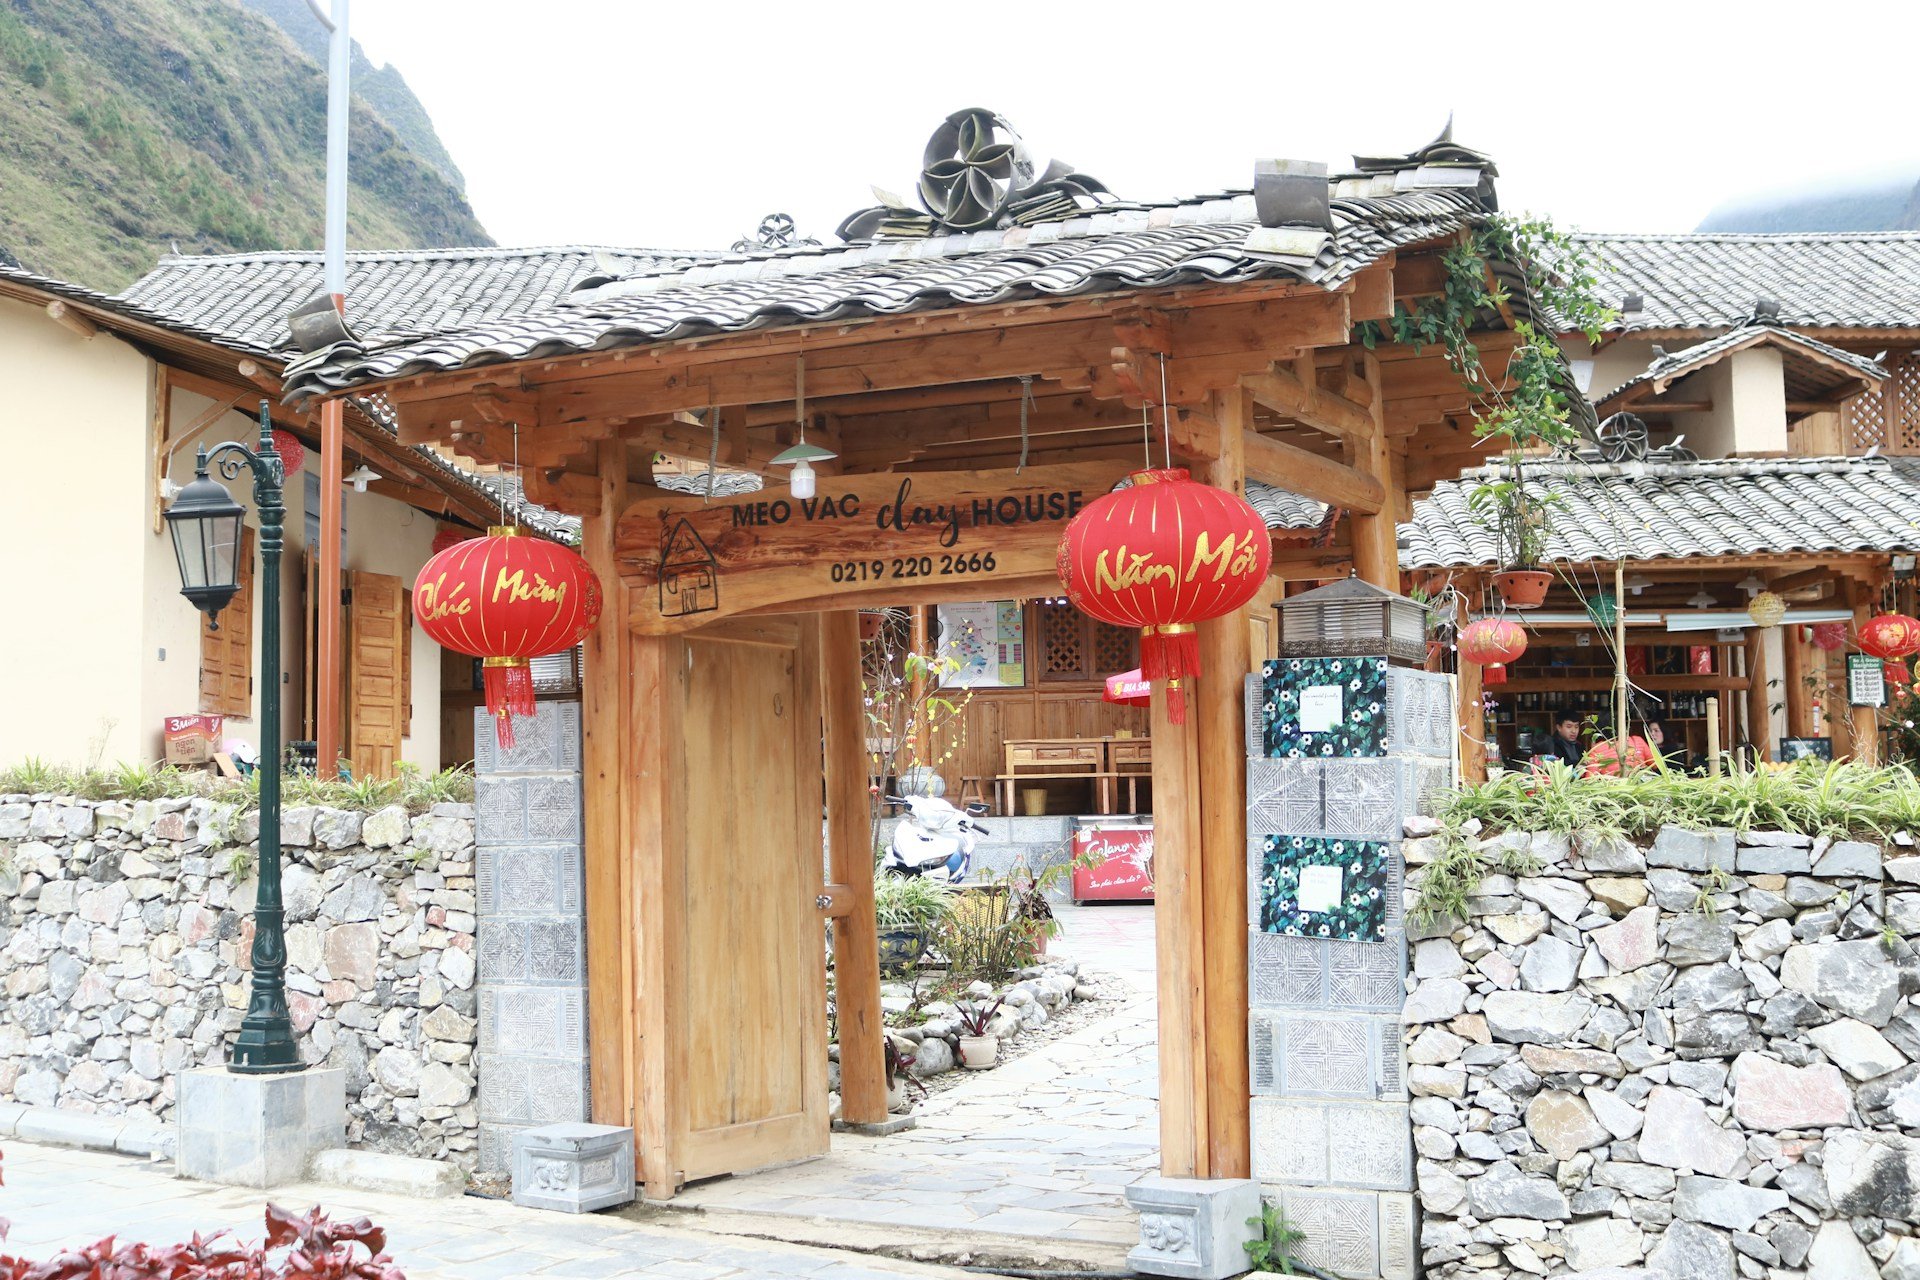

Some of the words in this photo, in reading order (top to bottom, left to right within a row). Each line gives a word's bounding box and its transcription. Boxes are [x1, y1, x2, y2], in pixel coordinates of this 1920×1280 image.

[732, 500, 791, 527] MEO
[801, 494, 860, 521] VAC
[876, 477, 965, 548] clay
[972, 491, 1083, 527] HOUSE
[831, 560, 884, 583] 0219
[891, 556, 932, 578] 220
[940, 551, 996, 575] 2666
[1095, 545, 1176, 594] Năm
[418, 572, 472, 622] Chúc
